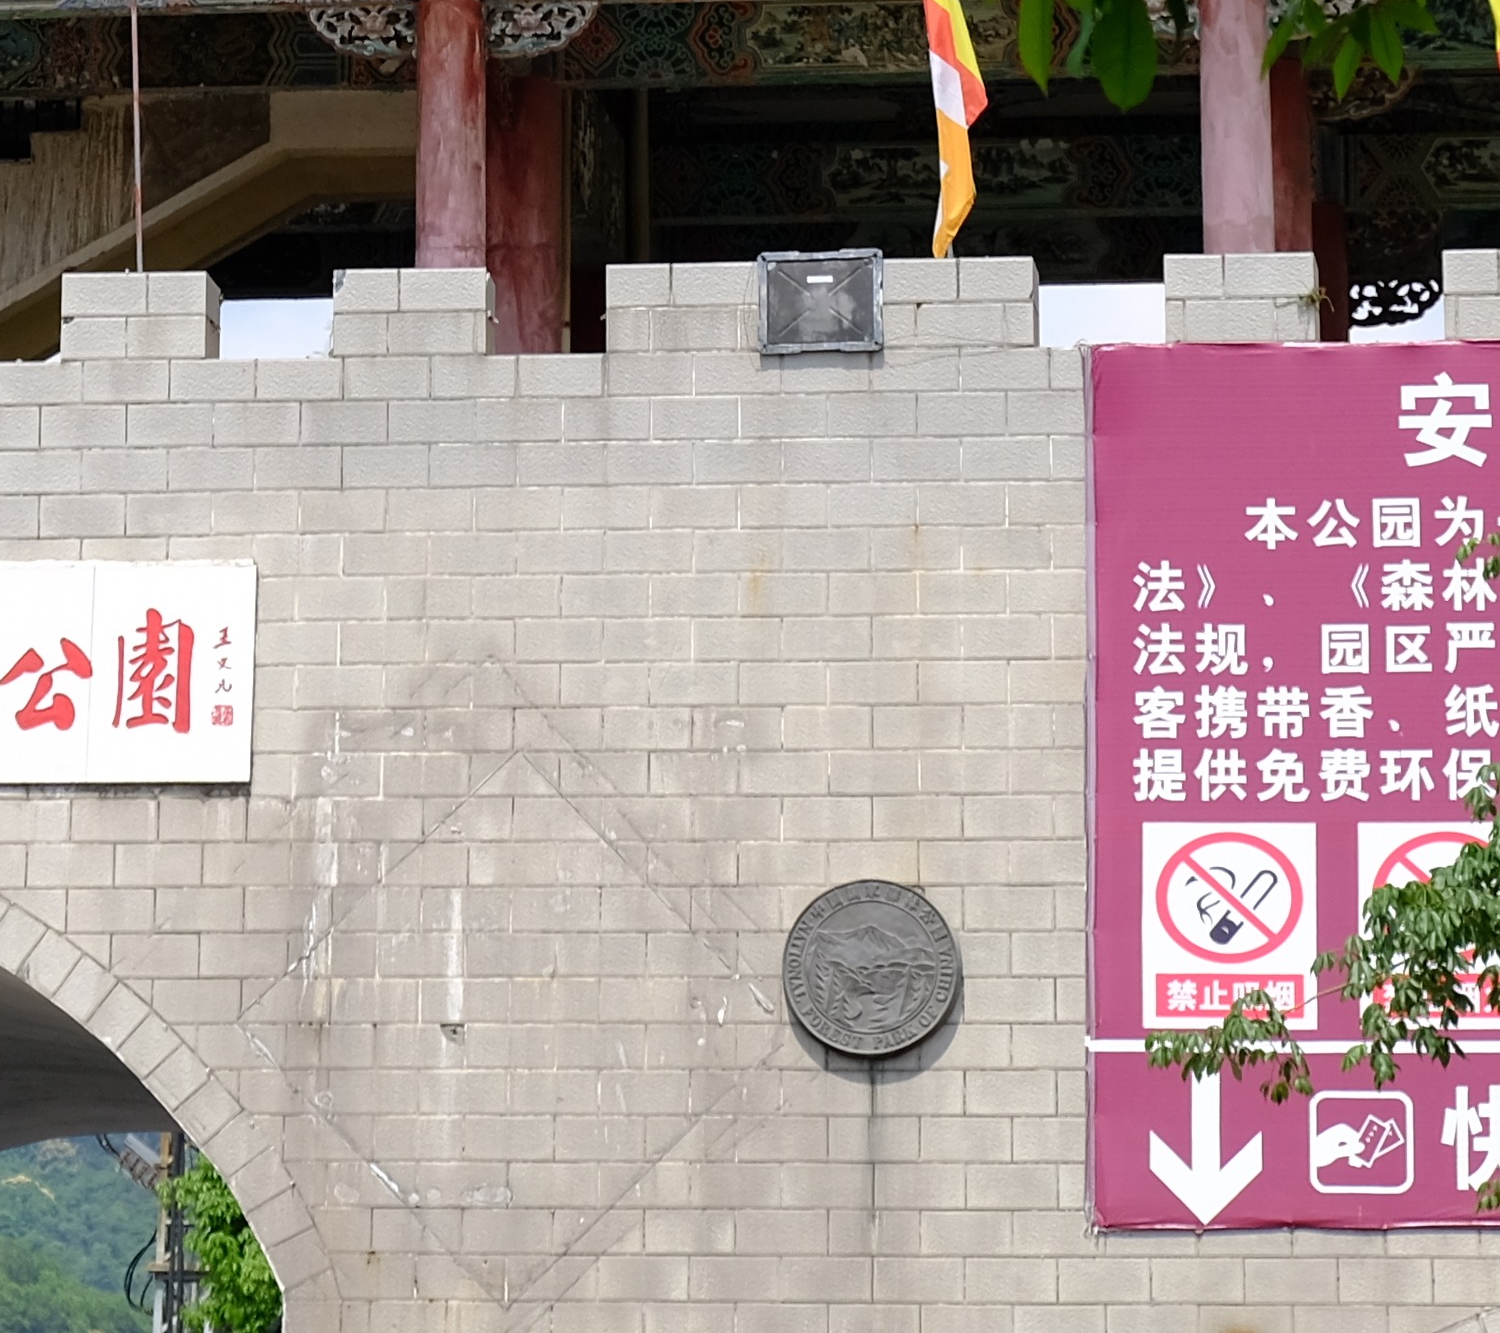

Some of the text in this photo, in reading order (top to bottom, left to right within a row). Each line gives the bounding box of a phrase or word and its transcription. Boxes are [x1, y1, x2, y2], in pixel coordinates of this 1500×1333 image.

[787, 920, 954, 1050] NATIONAL FOREST PARK OF CHINA
